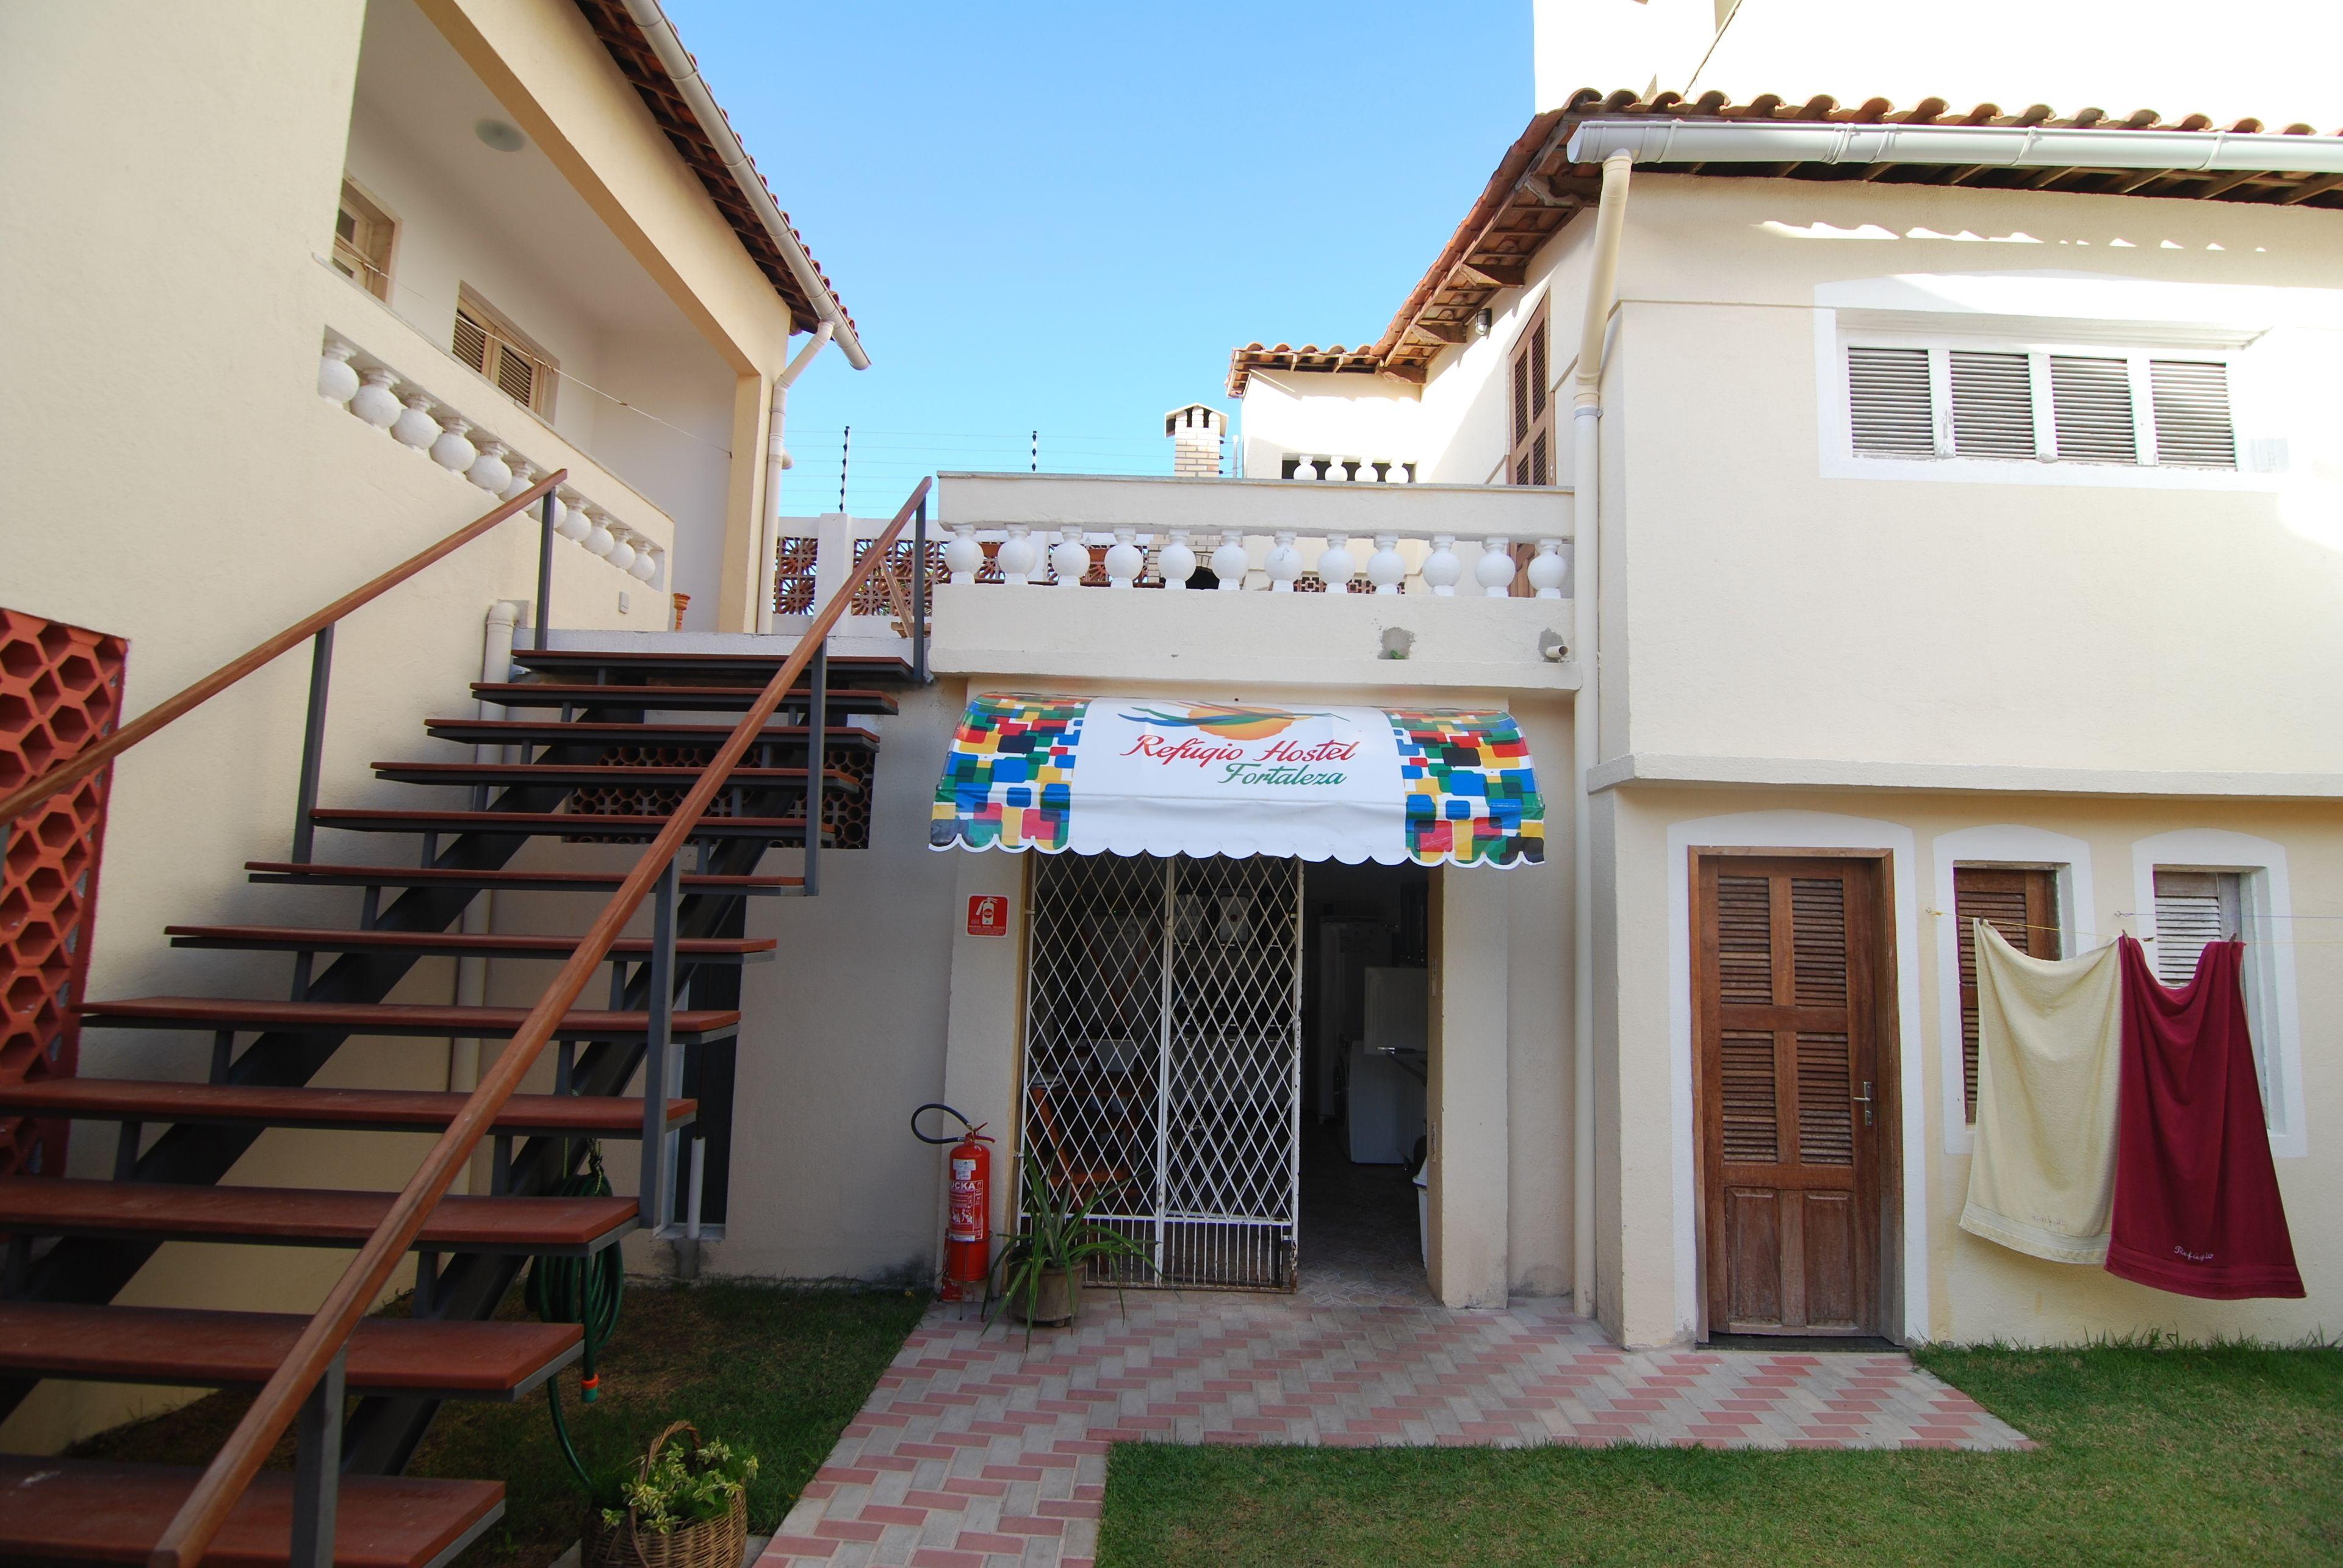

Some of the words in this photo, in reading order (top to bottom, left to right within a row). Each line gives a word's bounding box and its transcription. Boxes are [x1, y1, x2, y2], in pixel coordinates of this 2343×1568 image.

[1253, 739, 1360, 762] Hostel
[1217, 763, 1347, 785] Fortaleza
[950, 1181, 975, 1190] UCKA
